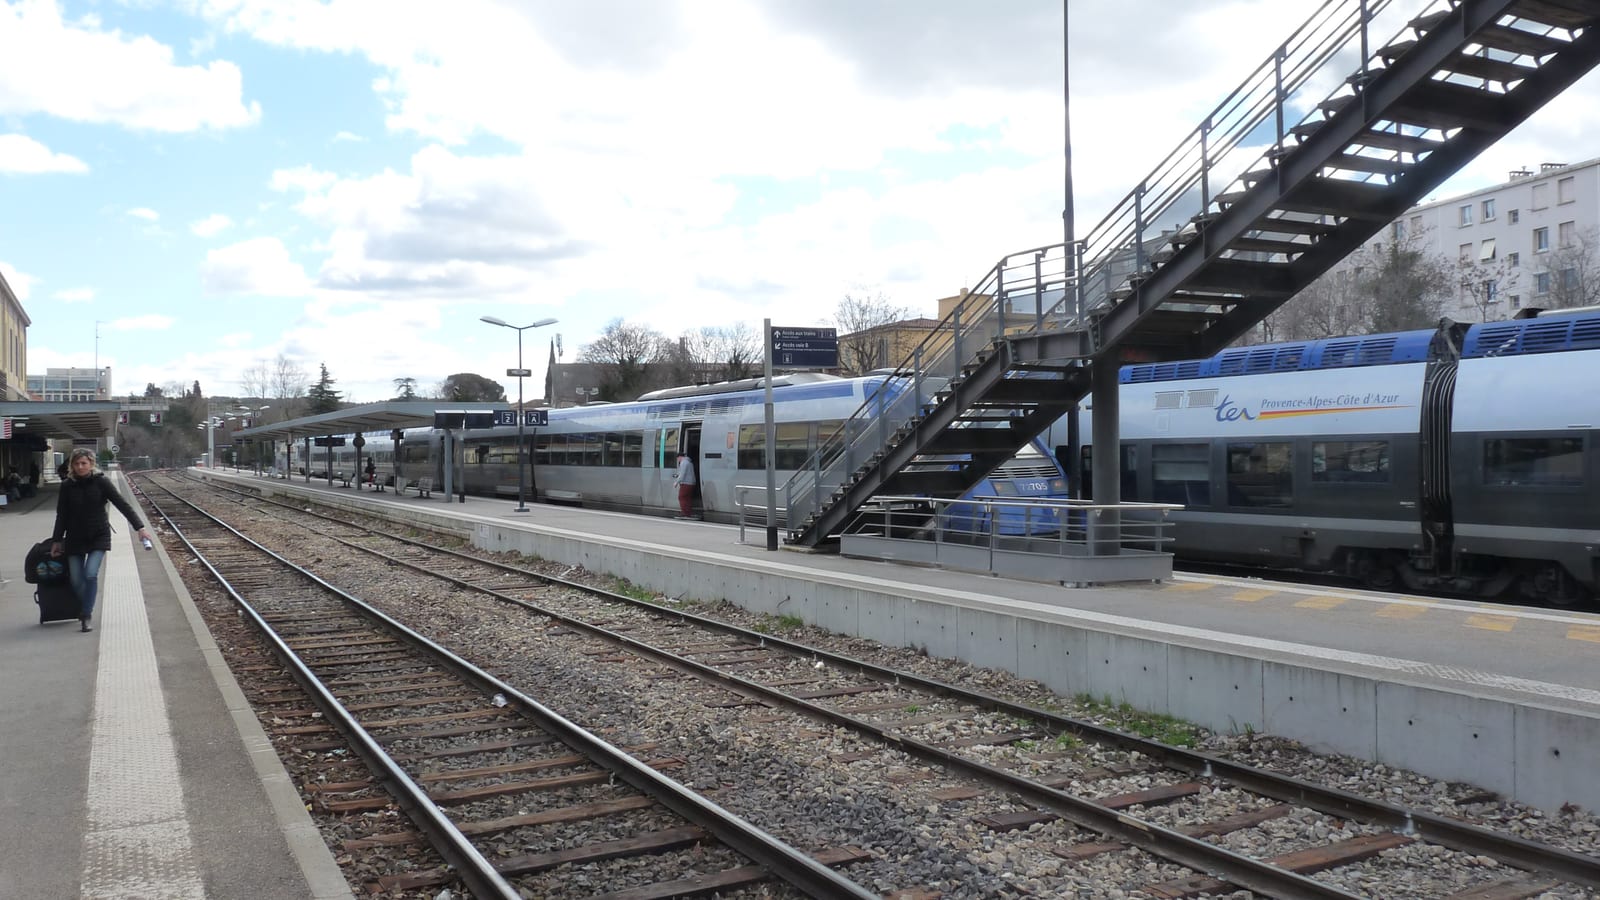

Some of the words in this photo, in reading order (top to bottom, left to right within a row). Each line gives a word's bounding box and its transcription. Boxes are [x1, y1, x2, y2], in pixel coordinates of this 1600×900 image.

[1215, 394, 1256, 421] ter
[1261, 394, 1361, 409] Provence-Alpes-Côte
[1363, 393, 1399, 405] d'Azur
